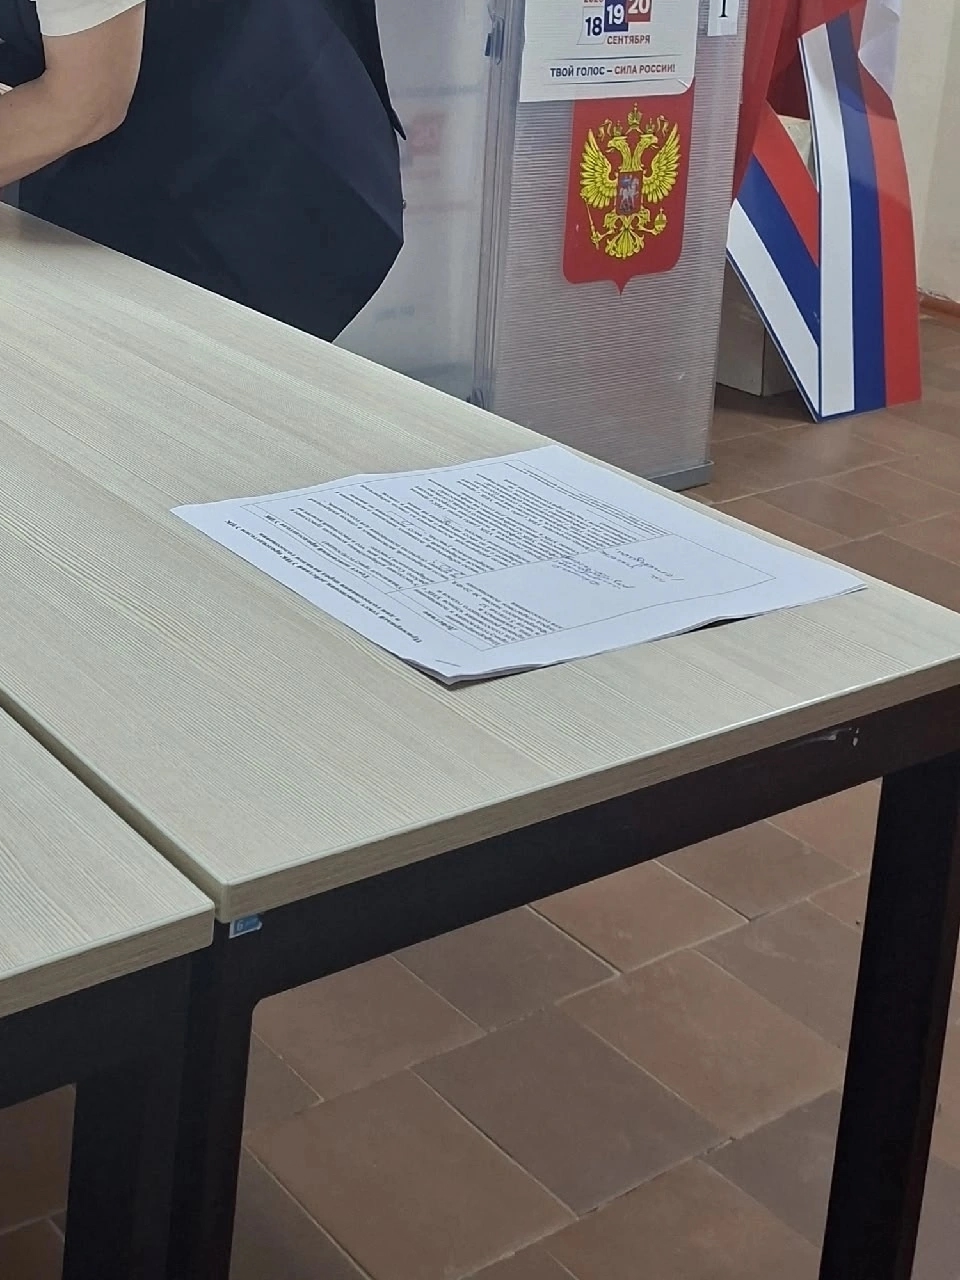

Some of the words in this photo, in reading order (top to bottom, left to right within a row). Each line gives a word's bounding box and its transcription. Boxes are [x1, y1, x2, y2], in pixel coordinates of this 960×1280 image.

[585, 16, 602, 37] 18
[606, 4, 625, 25] 19
[607, 35, 651, 45] СЕНТЯБРЯ
[550, 64, 574, 77] ТВОЙ
[575, 66, 606, 77] ГОЛОС
[614, 65, 638, 76] СИЛА
[639, 64, 675, 74] РОССИИ!
